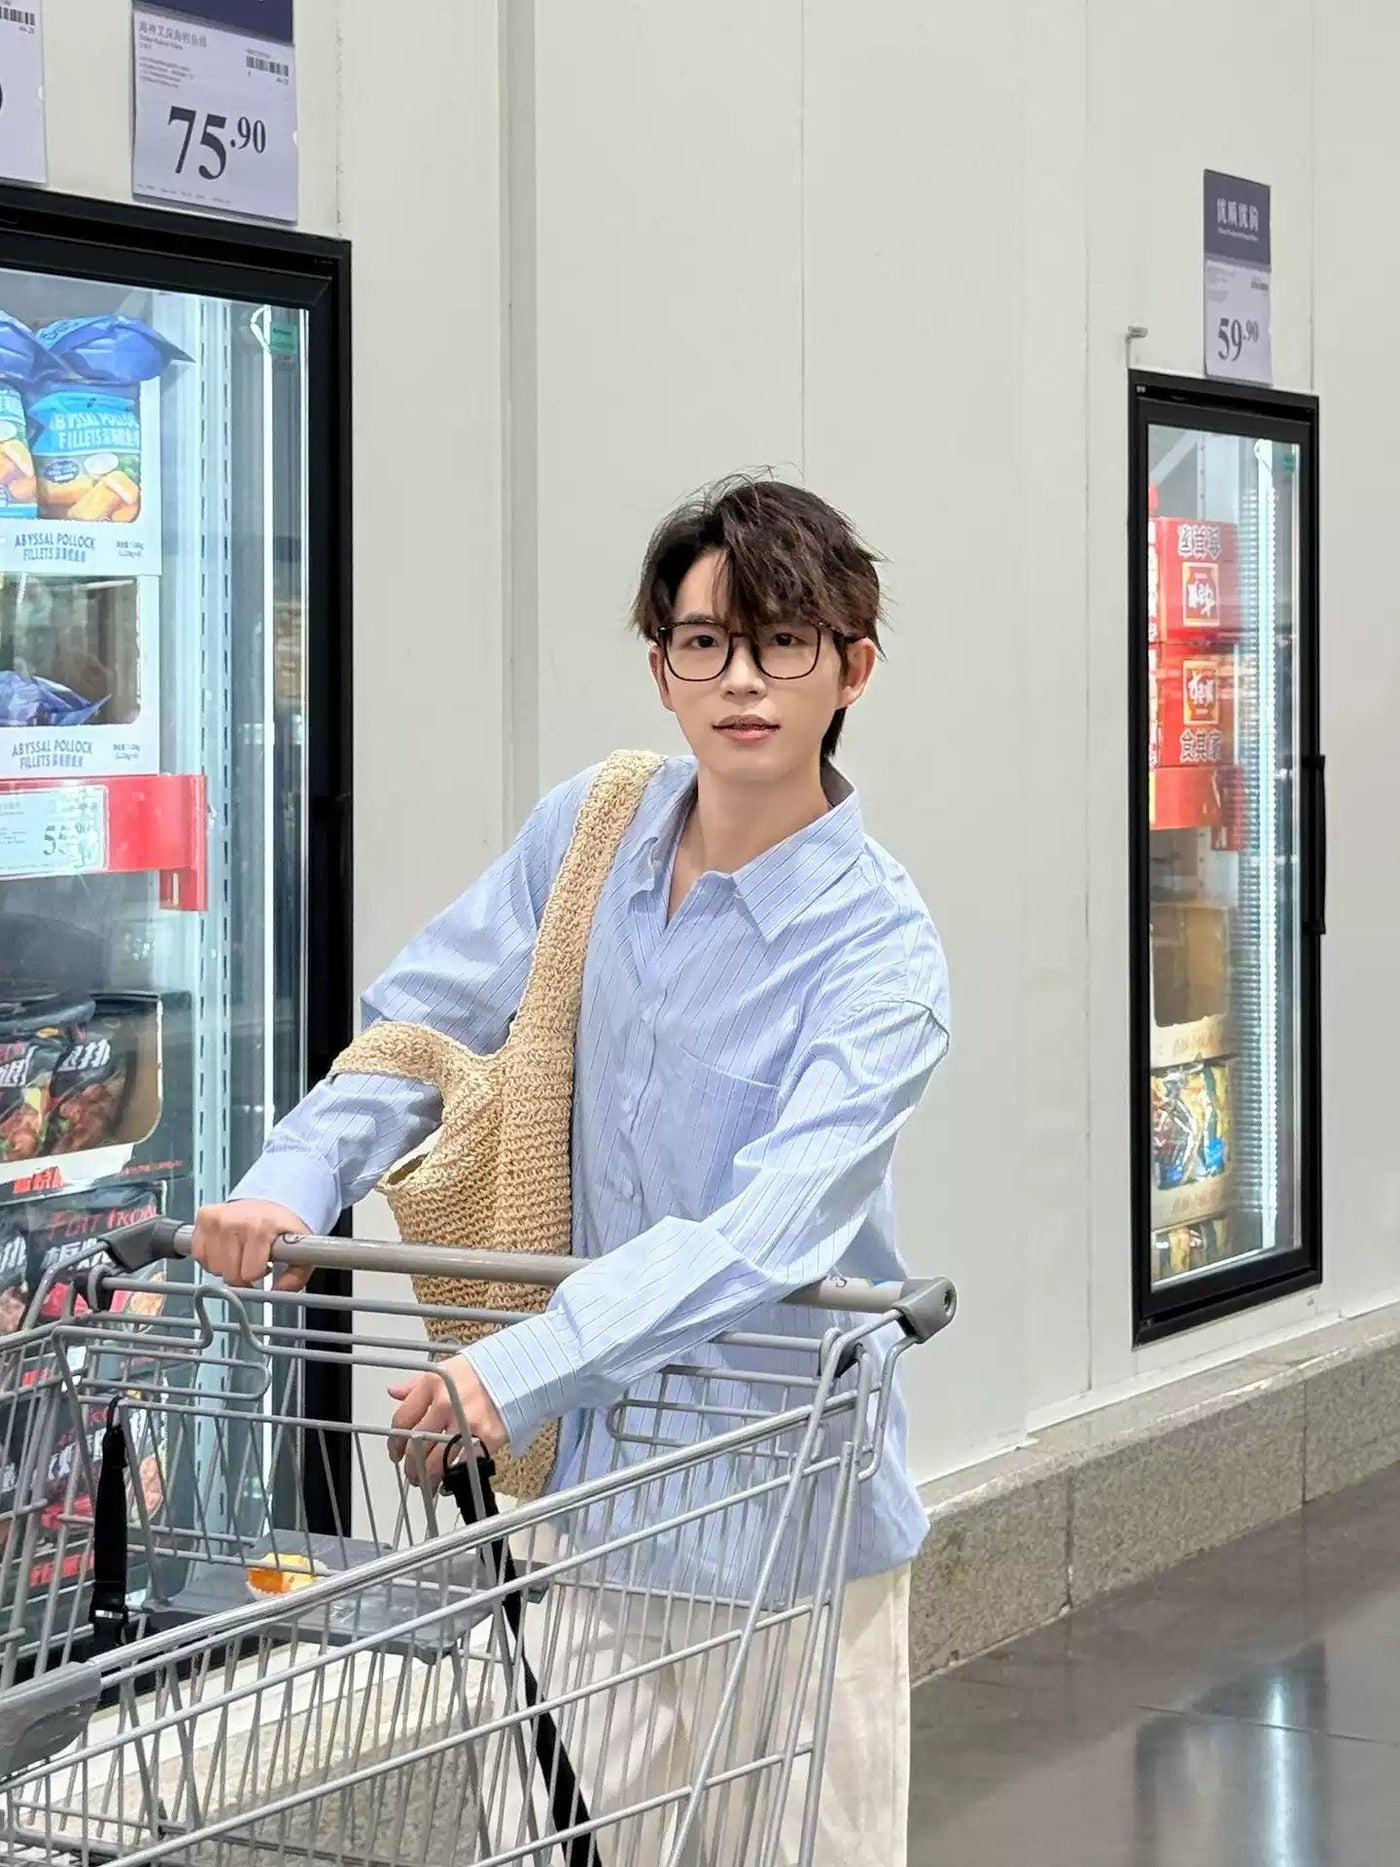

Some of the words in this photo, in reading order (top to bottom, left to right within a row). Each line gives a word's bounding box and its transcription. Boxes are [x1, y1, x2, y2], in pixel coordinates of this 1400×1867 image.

[14, 532, 54, 548] ABYSSAL
[57, 532, 96, 550] POLLOCK
[23, 547, 53, 561] FILLETS
[12, 739, 51, 757] ABYSSAL
[54, 739, 93, 755] POLLOCK
[20, 754, 50, 769] FILLETS
